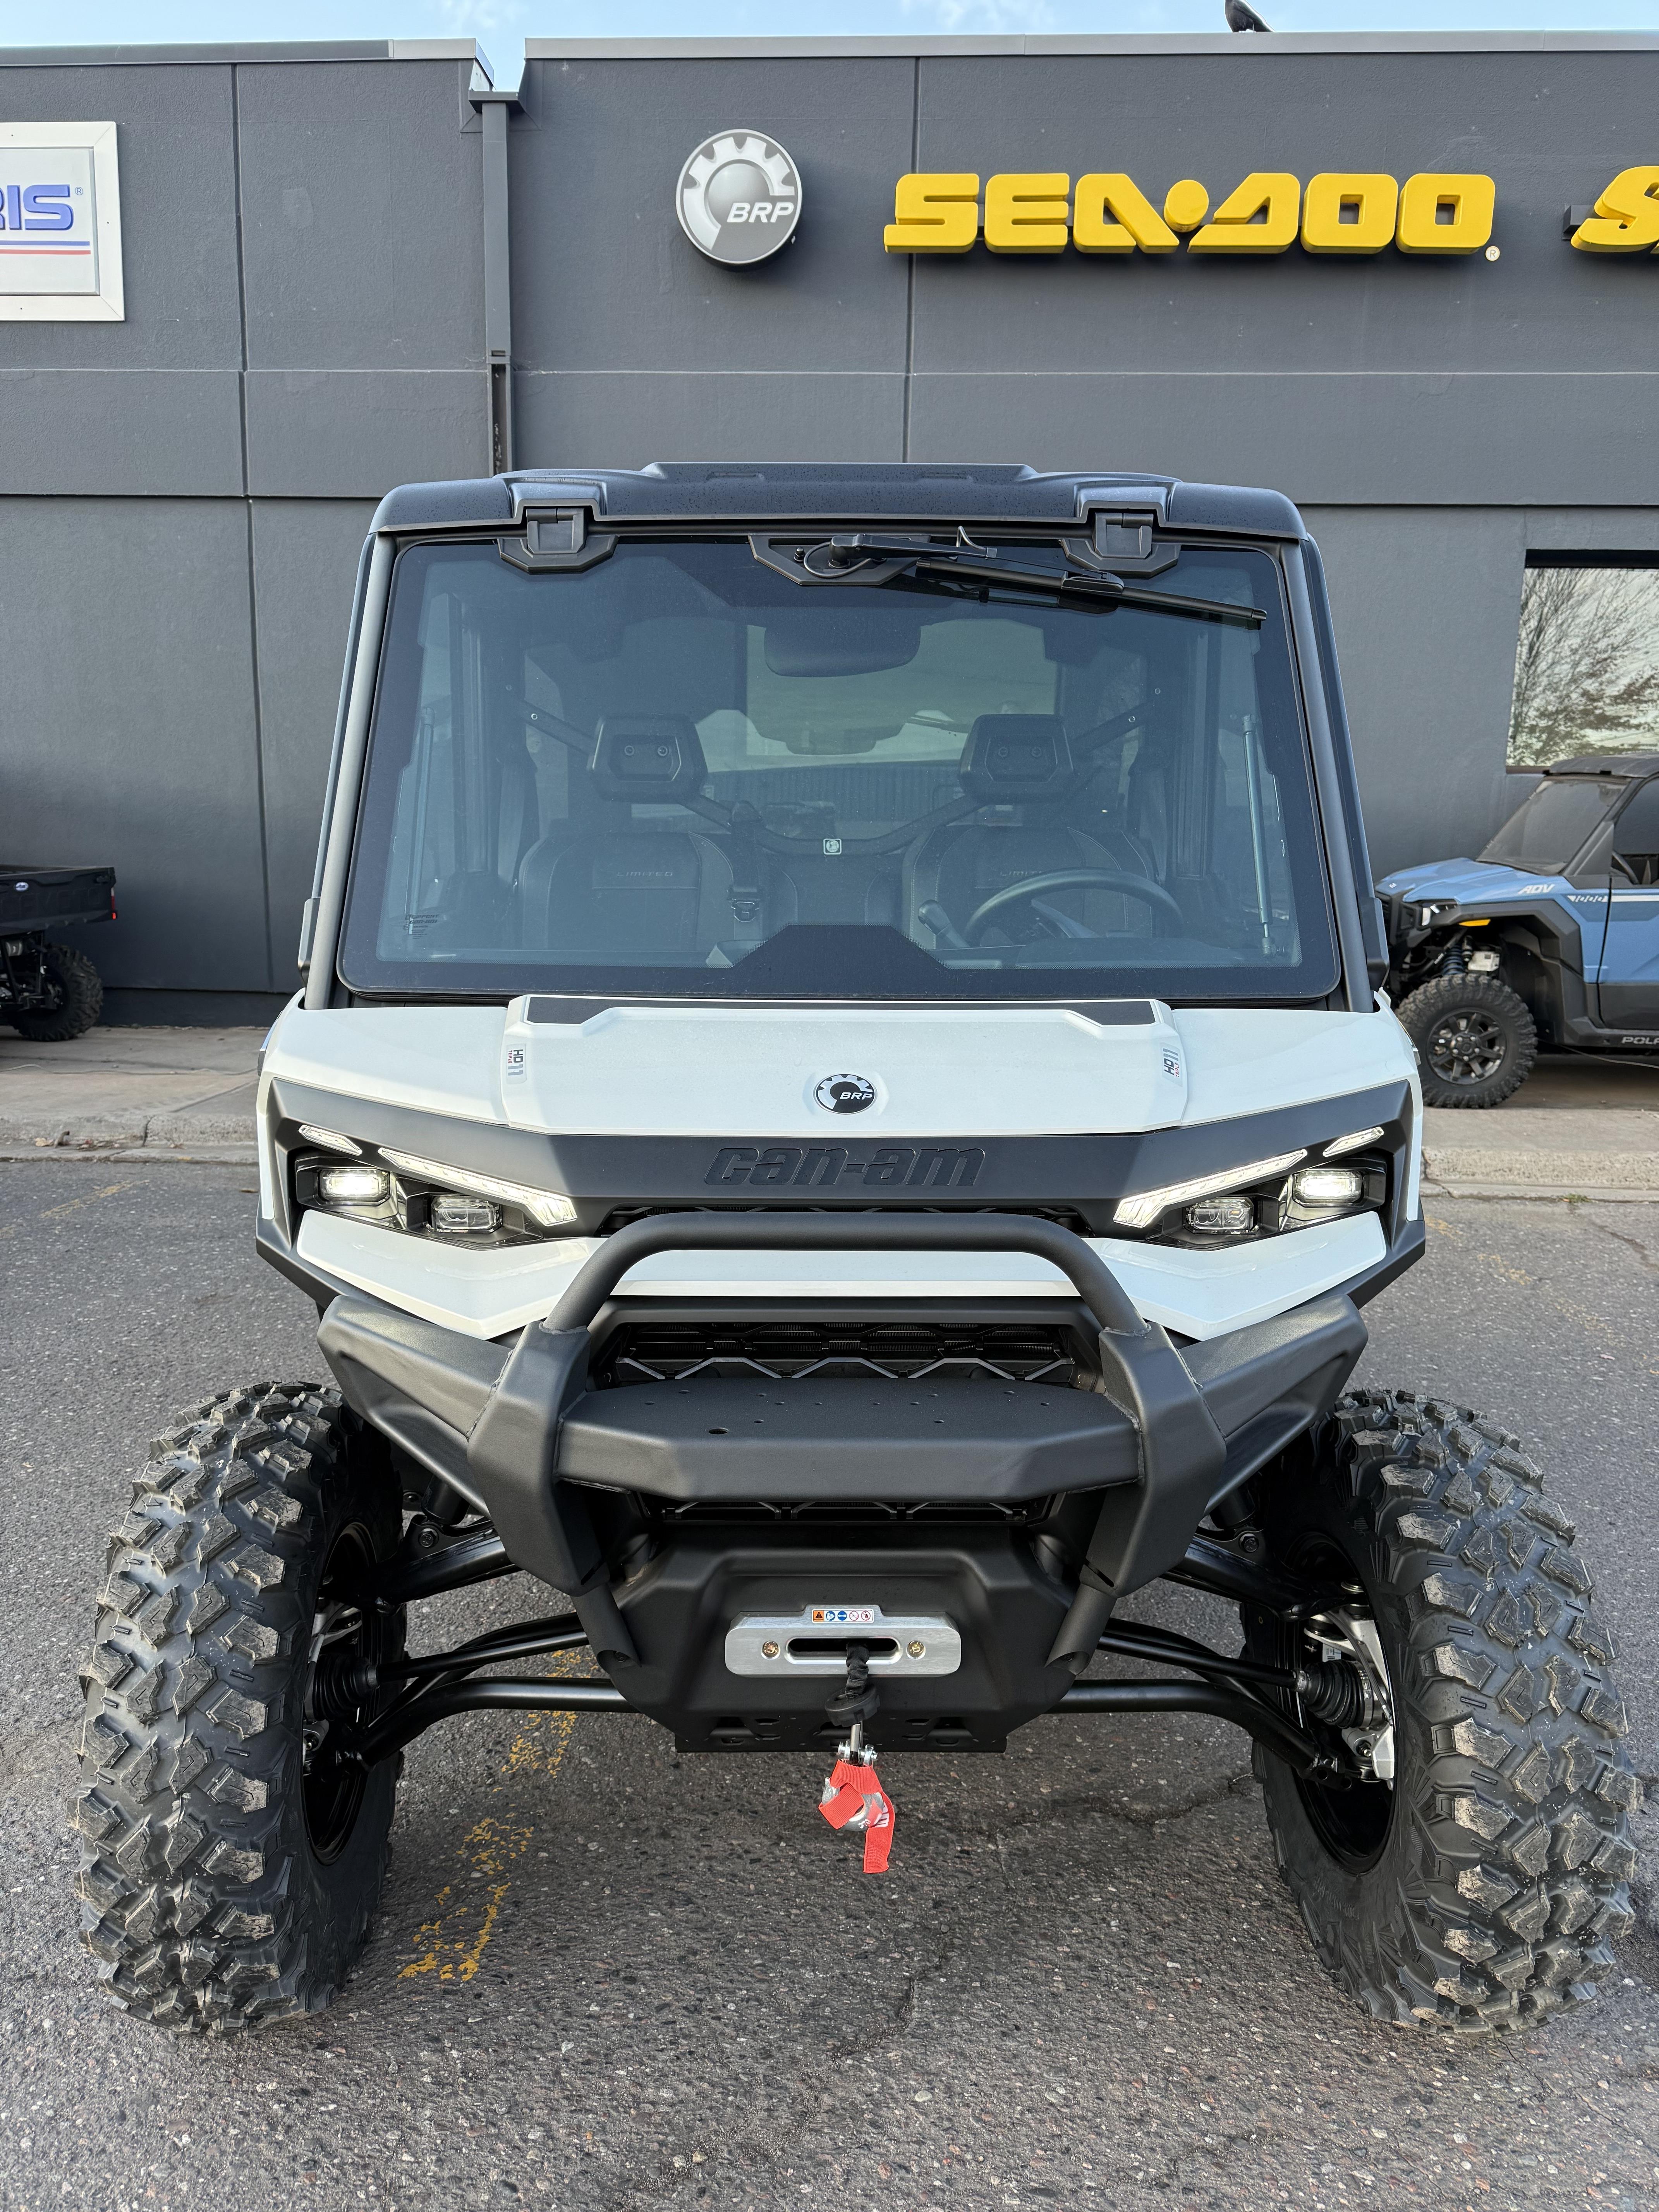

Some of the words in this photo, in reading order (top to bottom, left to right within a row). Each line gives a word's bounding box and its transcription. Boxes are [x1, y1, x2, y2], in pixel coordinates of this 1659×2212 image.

[726, 202, 794, 223] BRP
[1518, 883, 1556, 895] ADV
[840, 1092, 873, 1100] BRP
[704, 1147, 986, 1185] can-am
